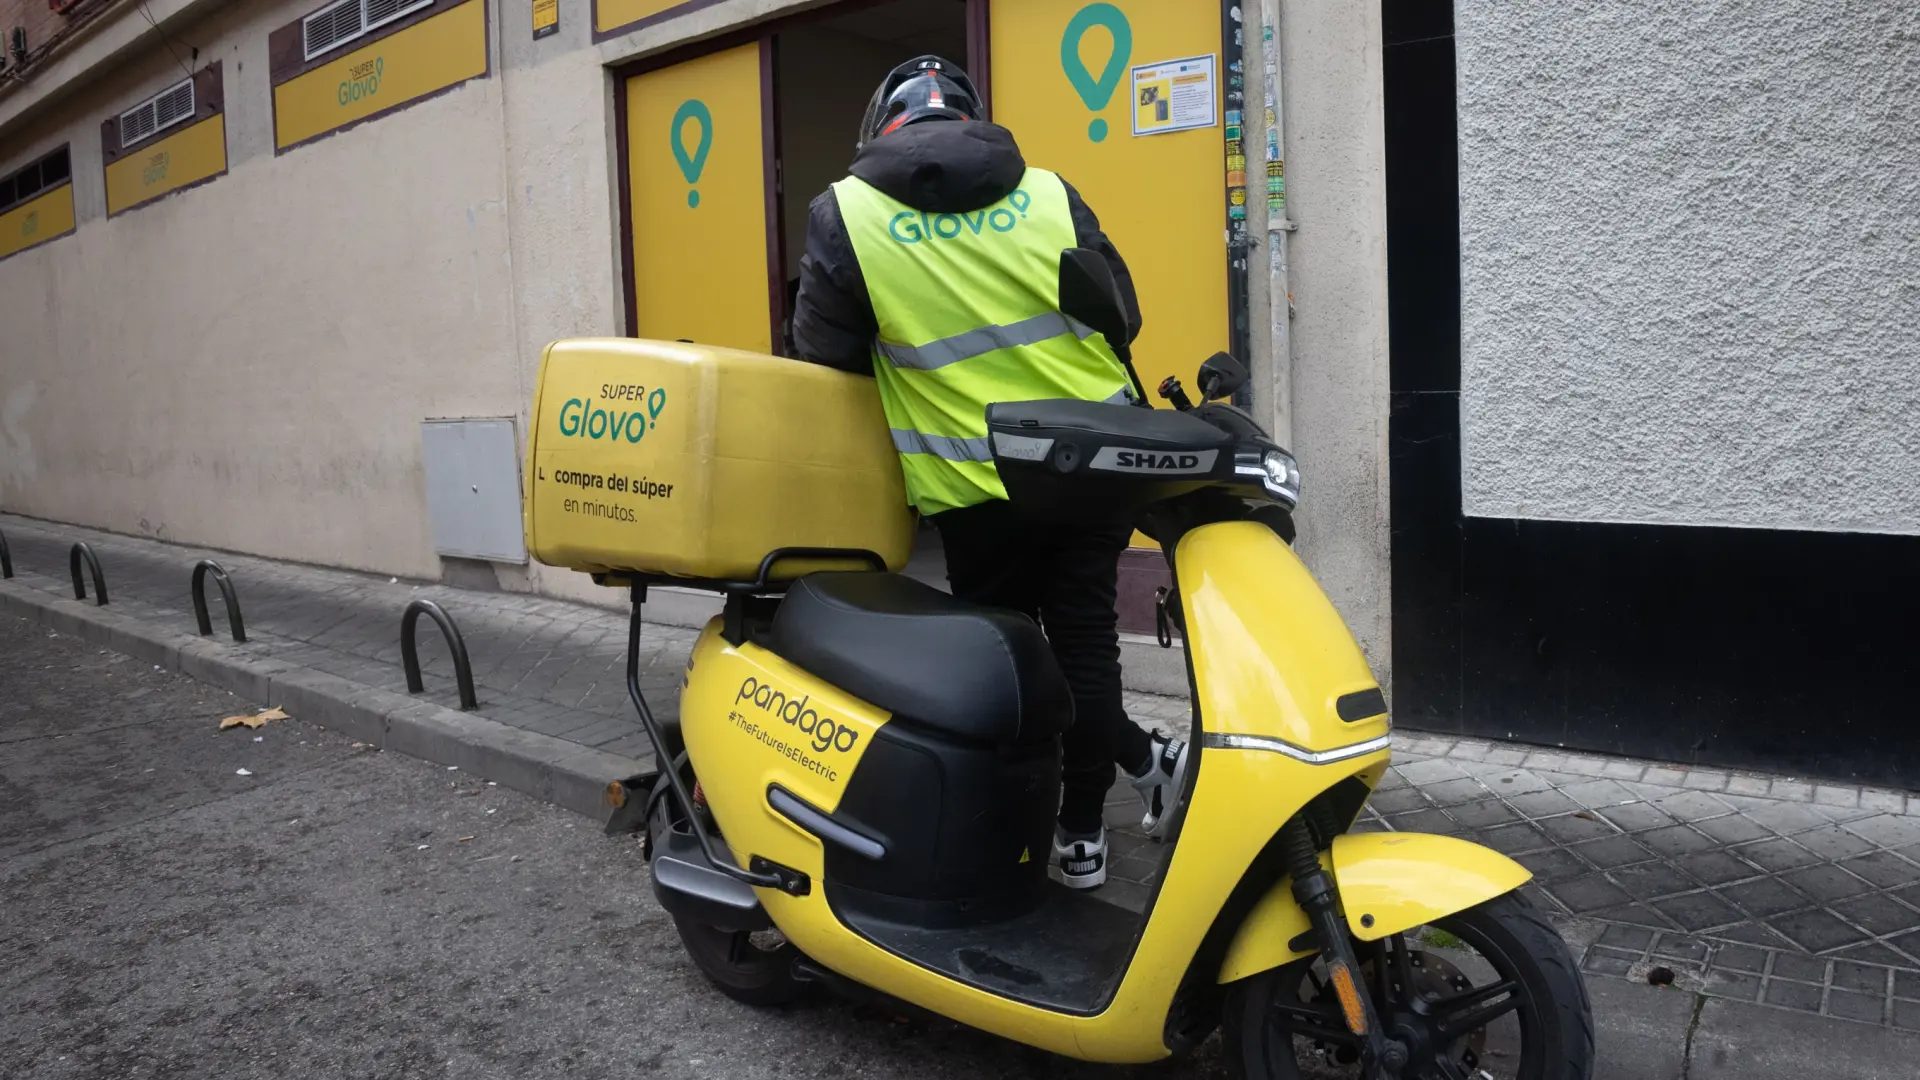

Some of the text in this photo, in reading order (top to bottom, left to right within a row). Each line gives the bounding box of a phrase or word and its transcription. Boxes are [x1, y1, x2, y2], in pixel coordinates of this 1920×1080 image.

[353, 60, 374, 78] SUPER
[338, 74, 378, 106] Glovo
[888, 208, 1016, 243] Glovo
[600, 383, 645, 401] SUPER
[559, 397, 646, 444] Glovo
[1116, 451, 1199, 469] SHAD
[554, 469, 603, 490] compra
[607, 473, 628, 492] del
[632, 476, 674, 499] súper
[563, 498, 638, 523] en minutos.
[735, 676, 859, 753] pandago
[728, 711, 838, 782] #TheFutureIsElectric
[1165, 739, 1181, 760] PUM
[1068, 859, 1097, 873] PUMA
